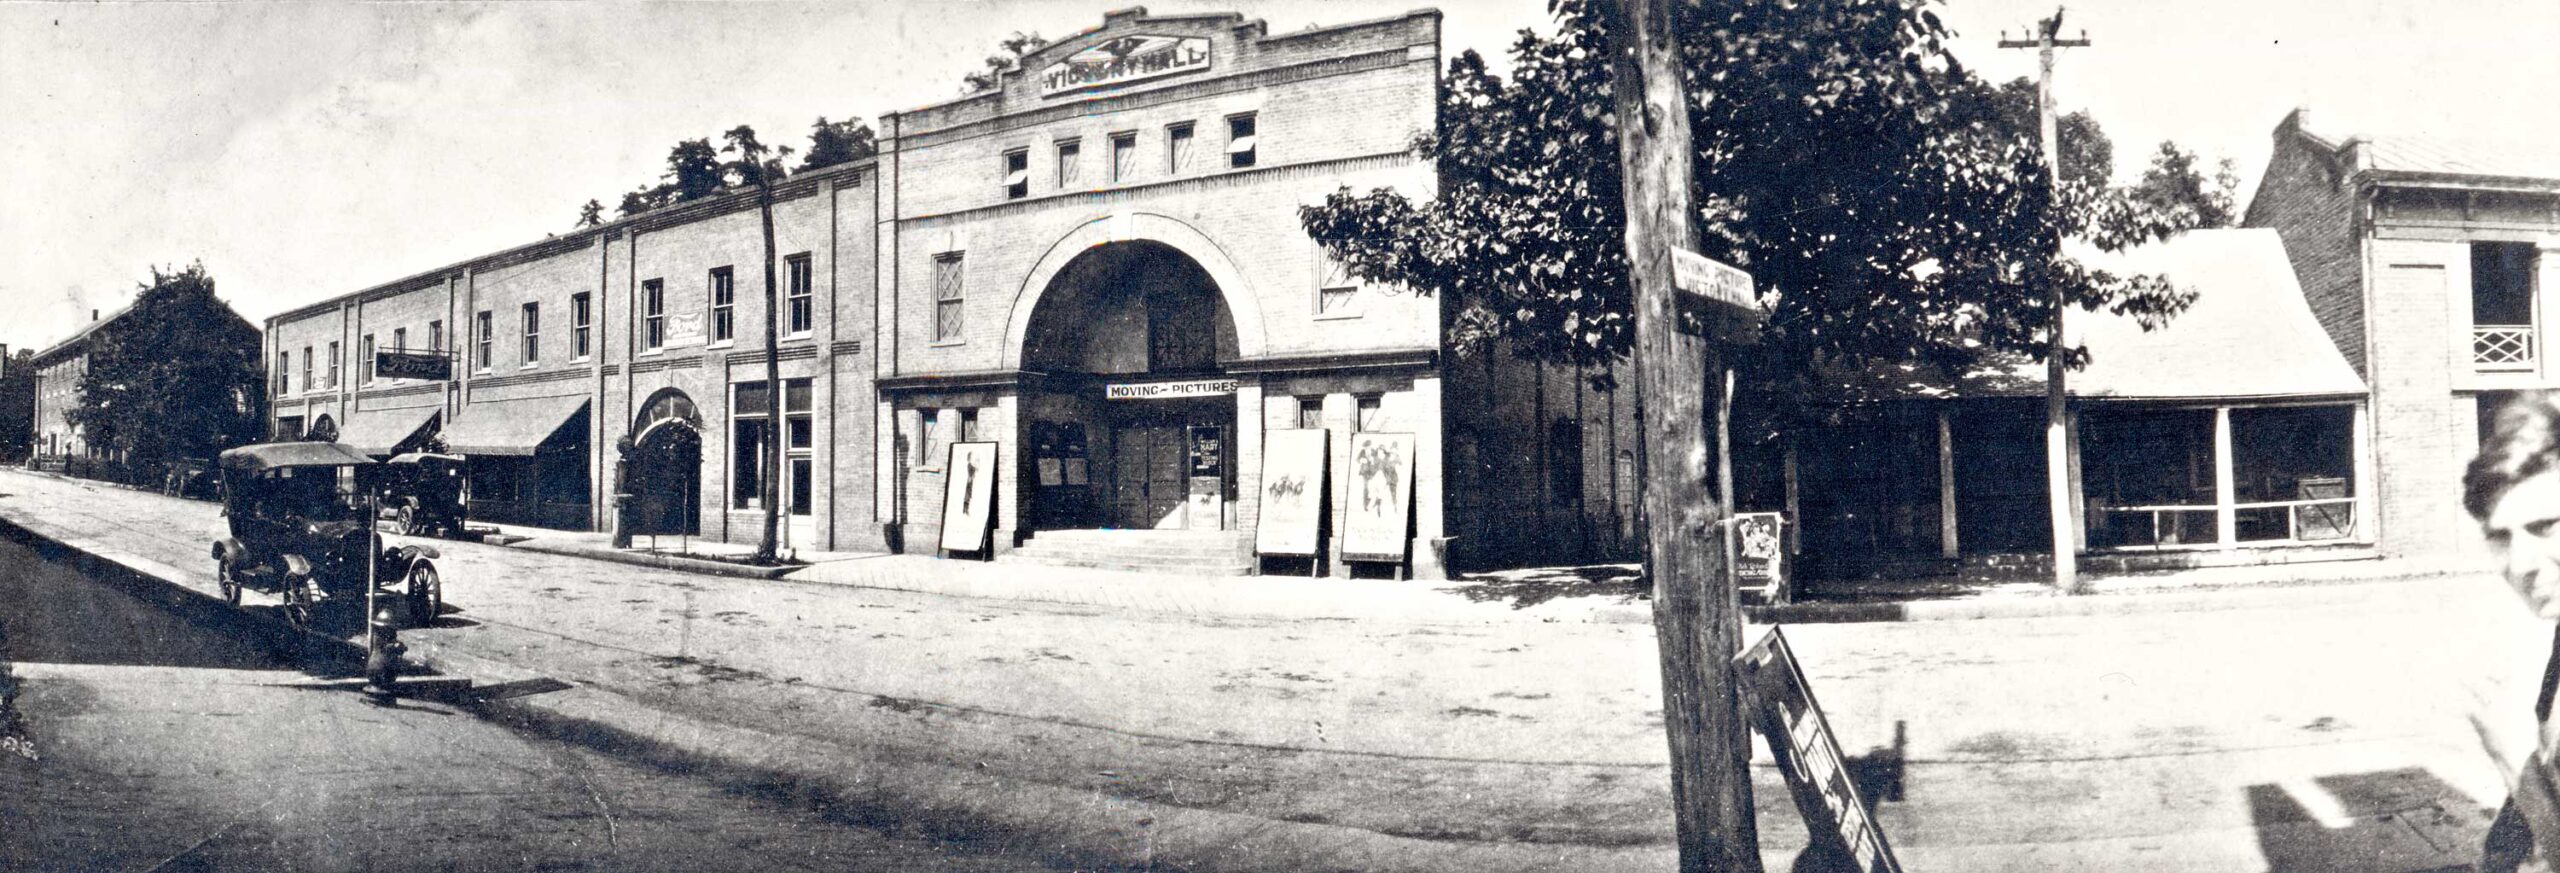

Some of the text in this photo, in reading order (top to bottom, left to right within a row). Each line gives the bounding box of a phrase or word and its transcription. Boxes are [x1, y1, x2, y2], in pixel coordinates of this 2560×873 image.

[666, 313, 703, 336] Ford
[382, 355, 443, 374] Ford
[1111, 385, 1159, 397] MOVING
[1172, 381, 1238, 394] PICTURES
